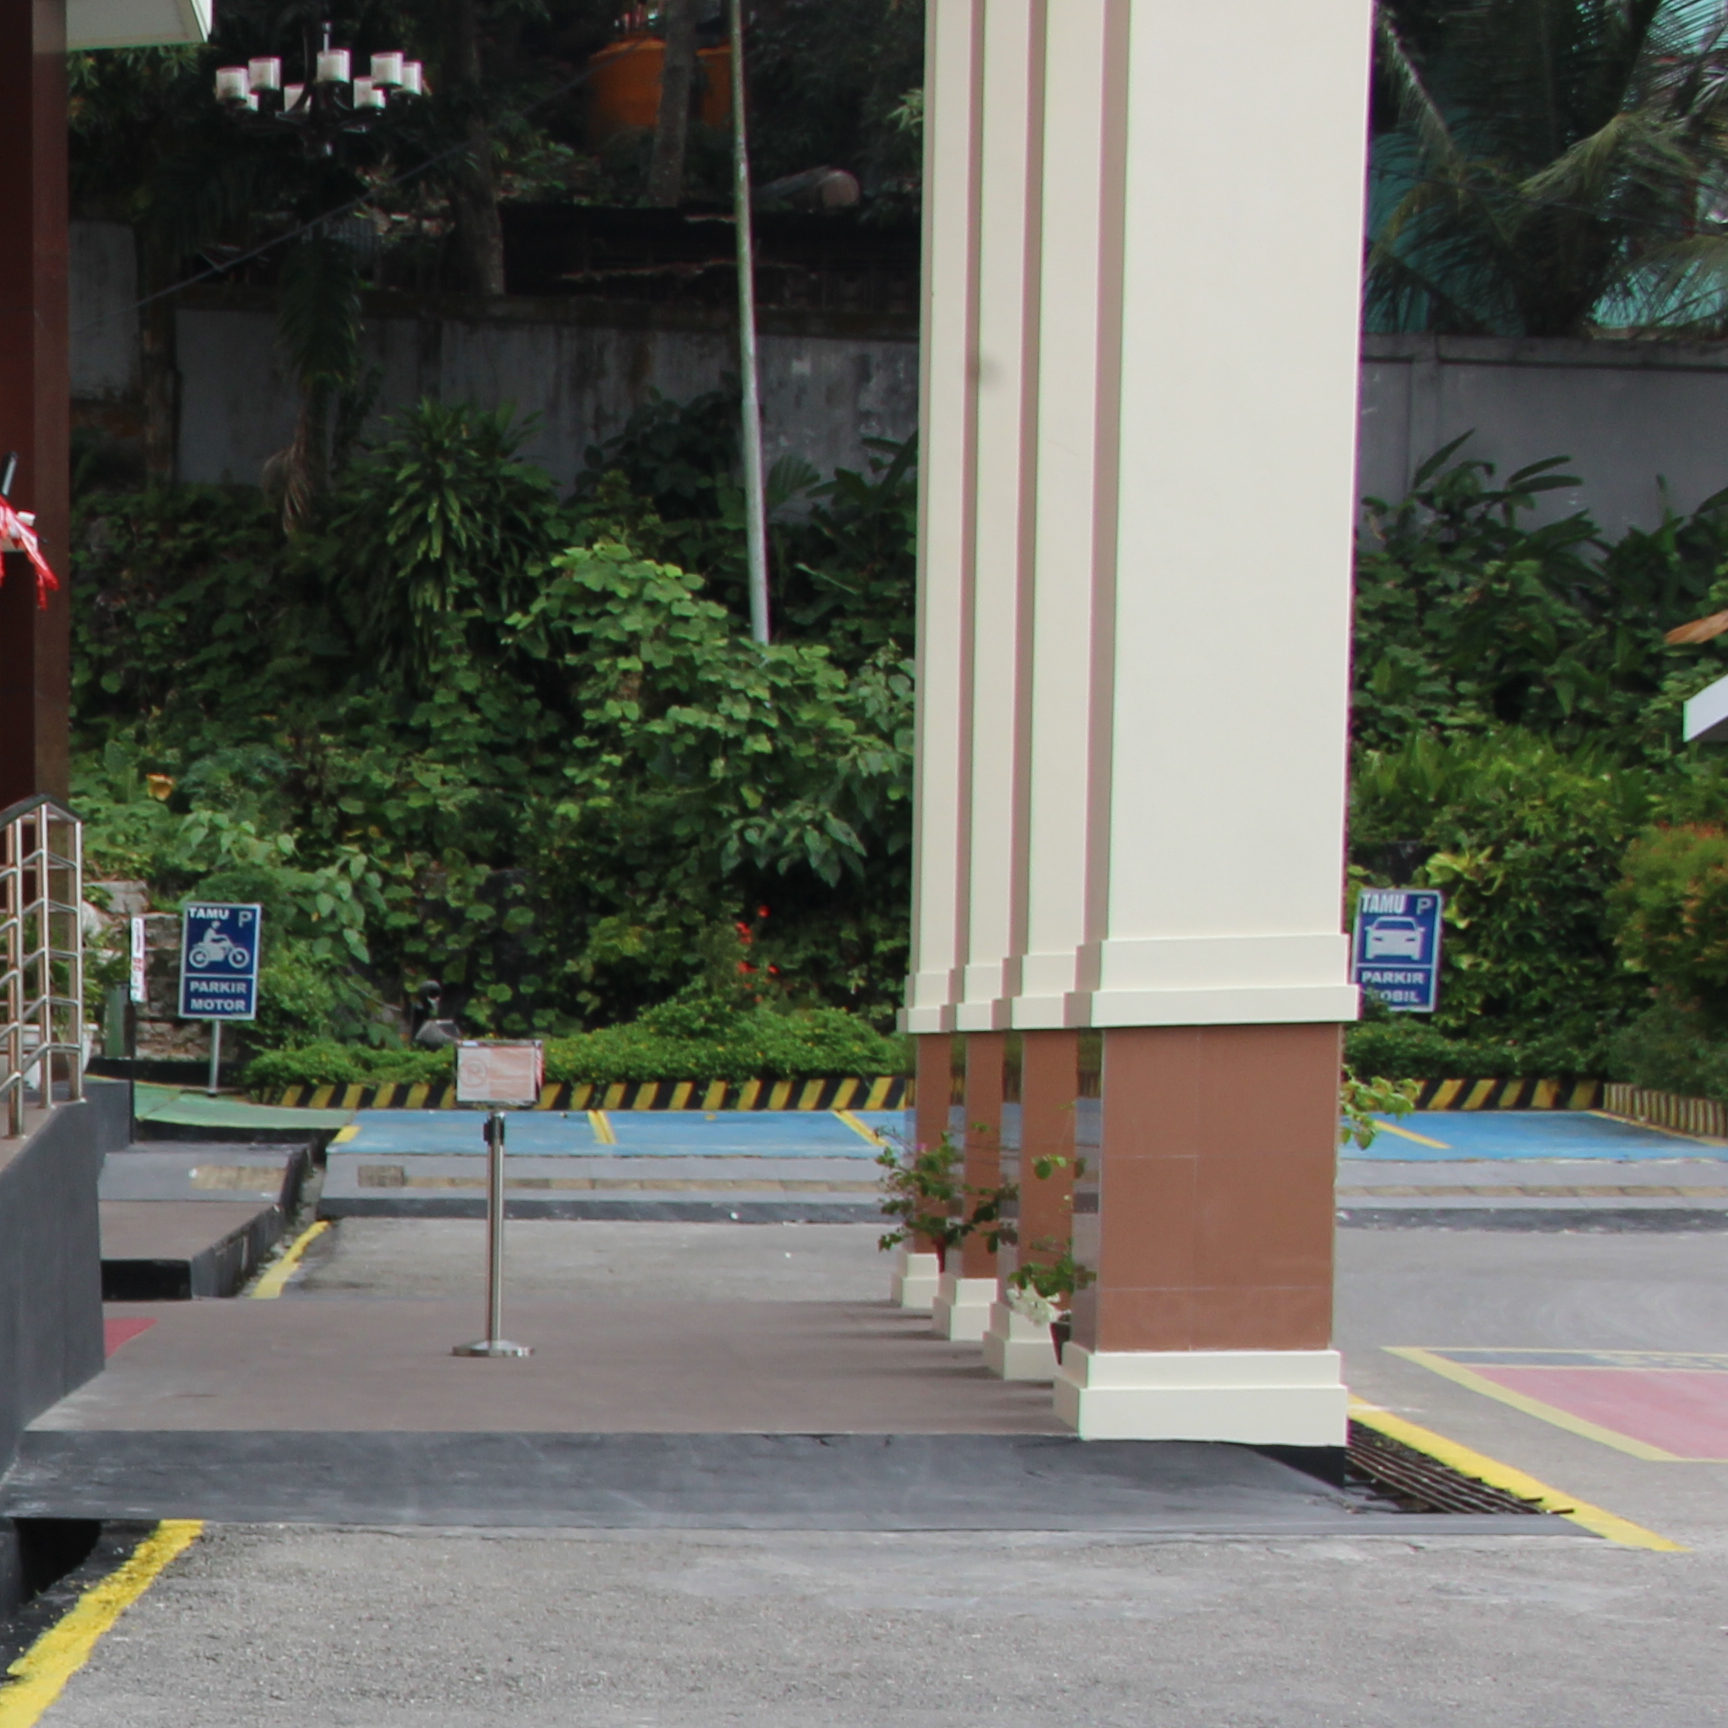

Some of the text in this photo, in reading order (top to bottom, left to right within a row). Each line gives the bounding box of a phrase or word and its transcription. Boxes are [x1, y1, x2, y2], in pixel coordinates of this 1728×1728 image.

[1362, 894, 1406, 914] TAMU
[1416, 898, 1431, 915] P
[188, 907, 230, 920] TAMU
[238, 911, 253, 928] P
[1361, 971, 1424, 984] PARKIR
[190, 981, 246, 994] PARKIR
[190, 998, 246, 1012] MOTOR
